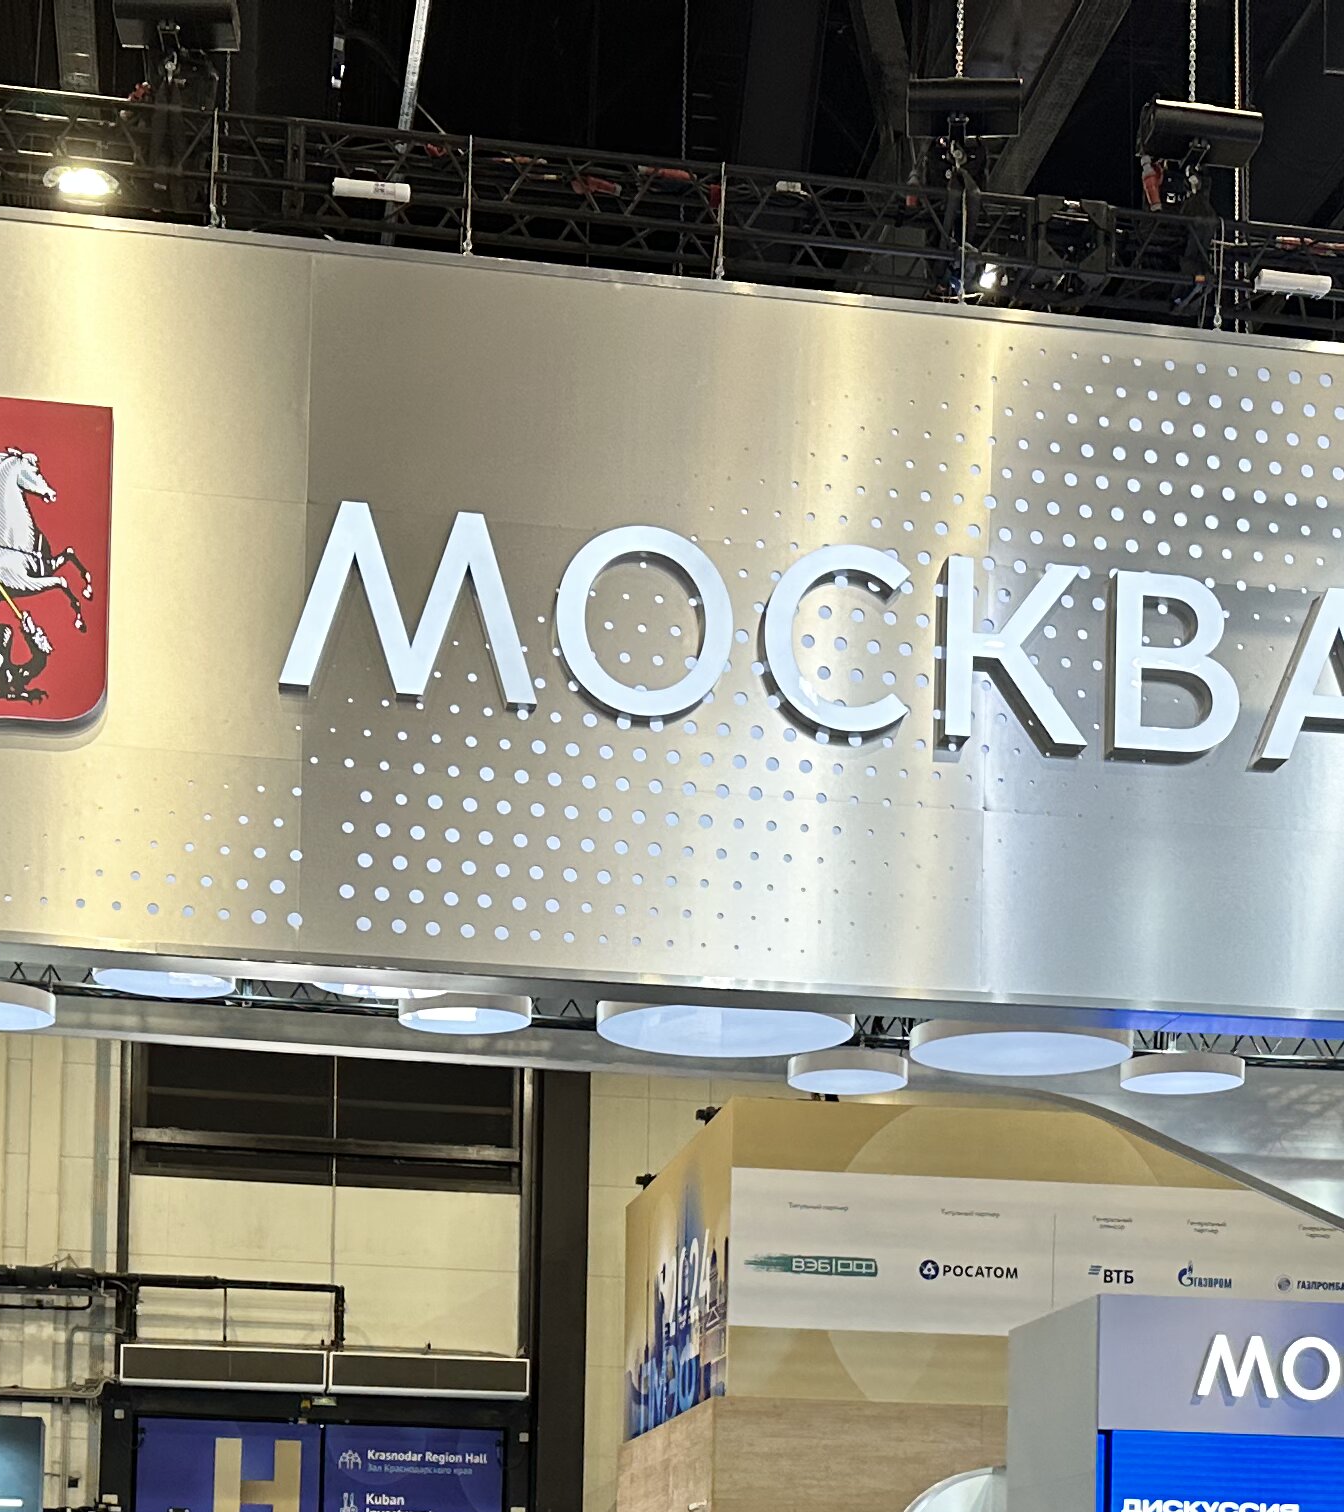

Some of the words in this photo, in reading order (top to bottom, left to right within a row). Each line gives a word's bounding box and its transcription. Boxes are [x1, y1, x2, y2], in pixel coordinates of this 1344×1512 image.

[942, 1264, 1019, 1279] РОСАТОМ
[1103, 1268, 1134, 1285] ВТБ
[367, 1449, 423, 1462] Krasnodar
[425, 1451, 463, 1465] Region
[465, 1453, 488, 1464] Hall
[365, 1493, 405, 1506] Kuban
